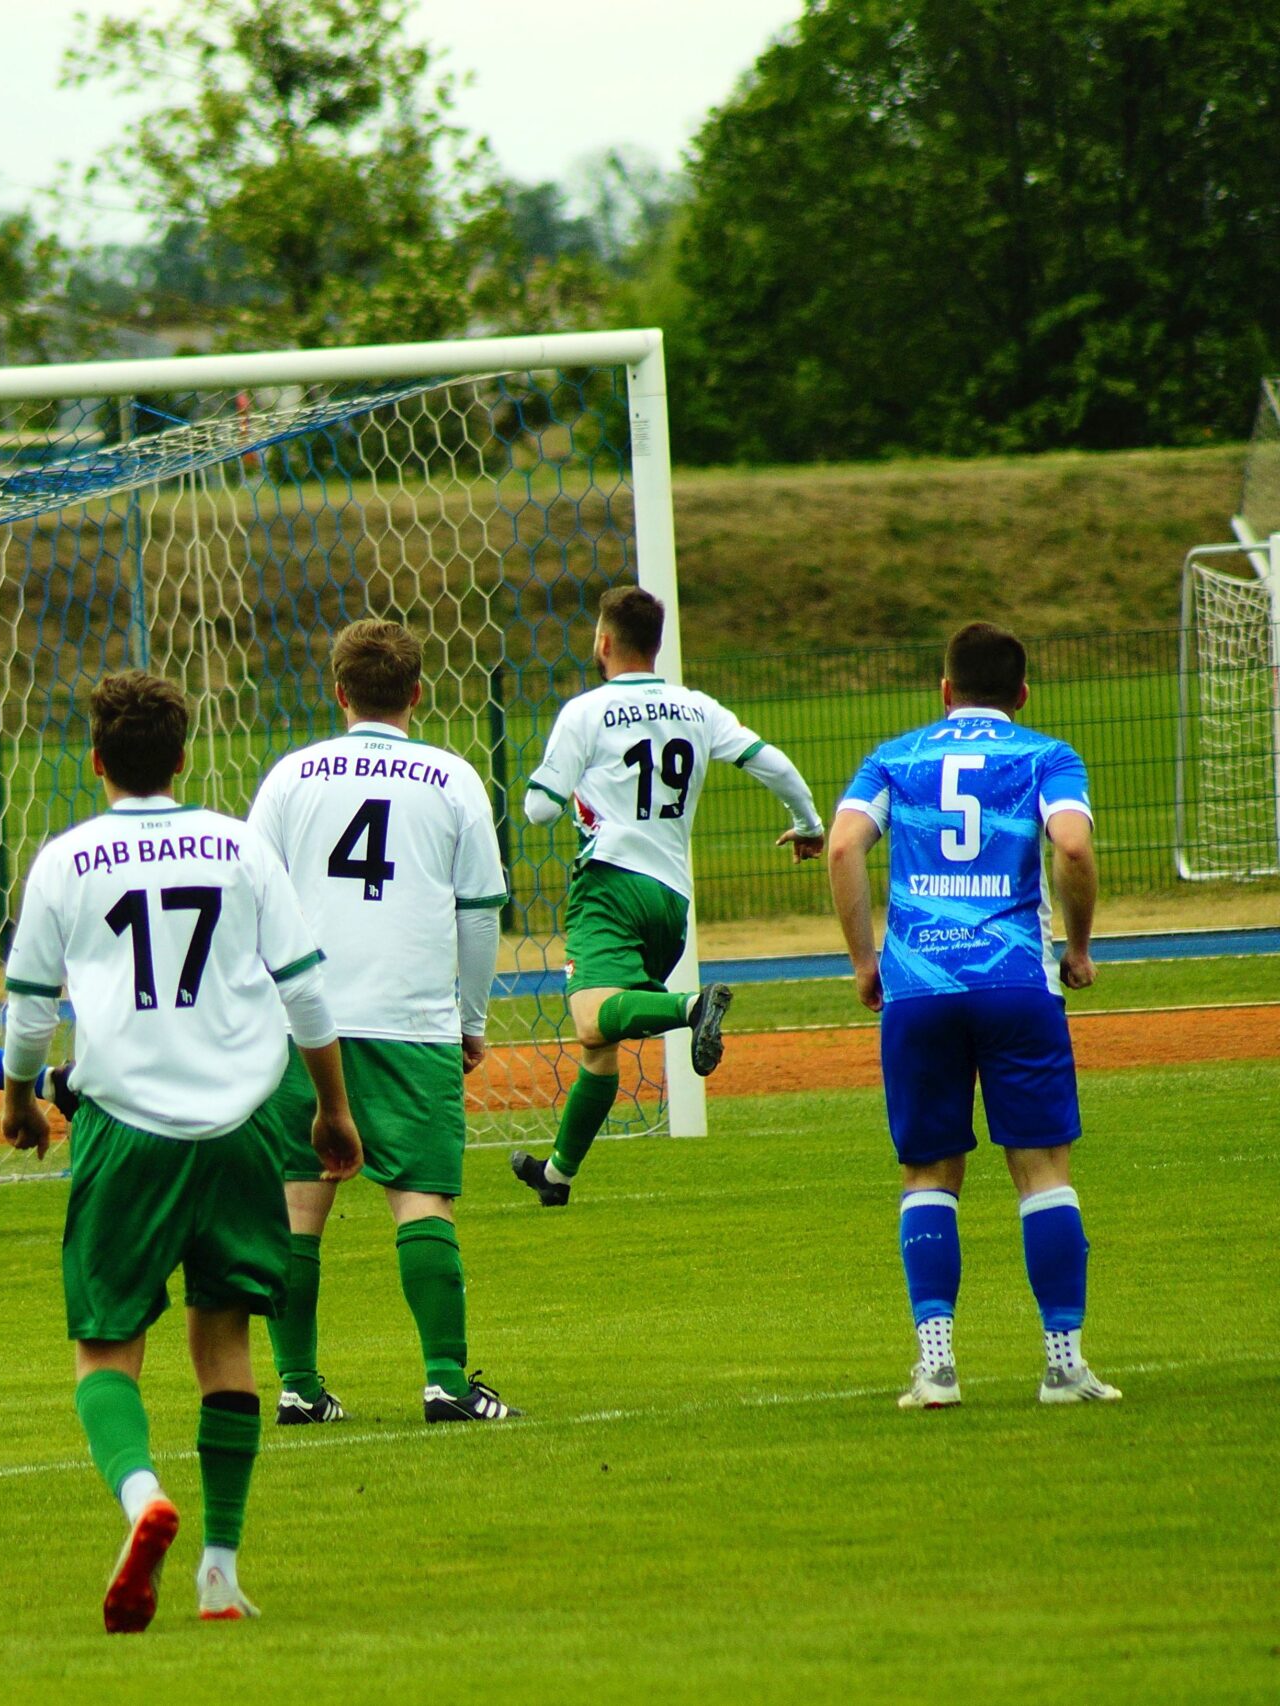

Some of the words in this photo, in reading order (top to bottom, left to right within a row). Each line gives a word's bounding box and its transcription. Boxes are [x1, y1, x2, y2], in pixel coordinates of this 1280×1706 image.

[603, 705, 642, 728] DĄB
[646, 702, 706, 724] BARCIN
[363, 742, 393, 751] 1963
[300, 756, 349, 782] DĄB
[354, 758, 450, 789] BARCIN
[623, 737, 695, 821] 19
[940, 753, 986, 862] 5
[73, 840, 131, 877] DĄB
[137, 835, 241, 863] BARCIN
[327, 798, 396, 902] 4
[909, 874, 1012, 898] SZUBINIANKA
[104, 885, 223, 1011] 17
